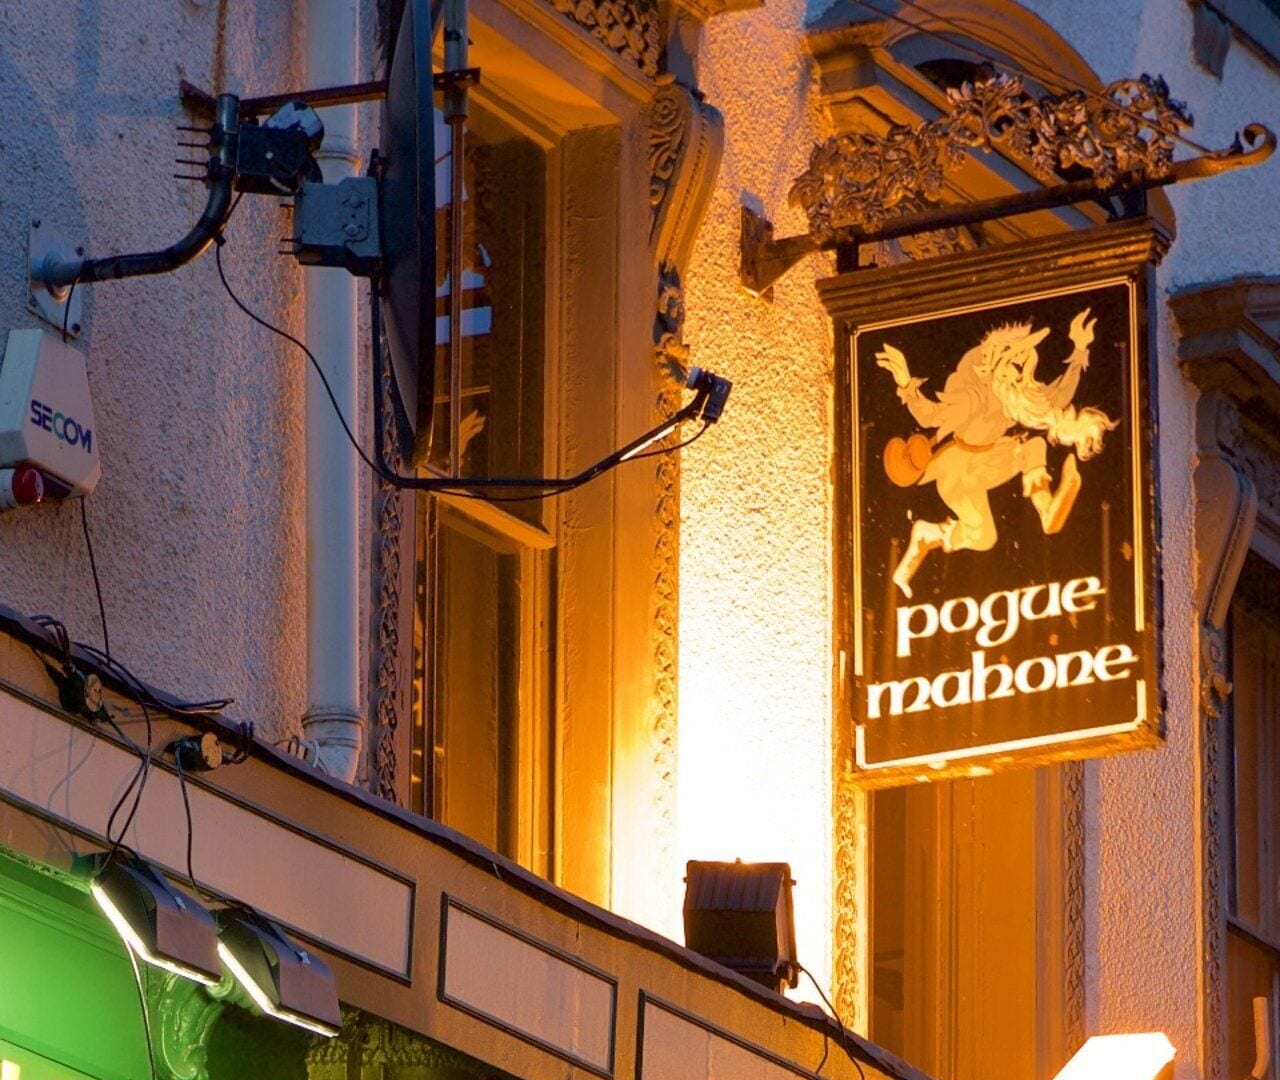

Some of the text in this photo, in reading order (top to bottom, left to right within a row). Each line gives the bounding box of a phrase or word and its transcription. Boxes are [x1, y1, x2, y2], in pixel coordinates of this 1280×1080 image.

[31, 399, 92, 454] SECOM
[896, 576, 1107, 658] pogue
[867, 644, 1139, 718] mahone
